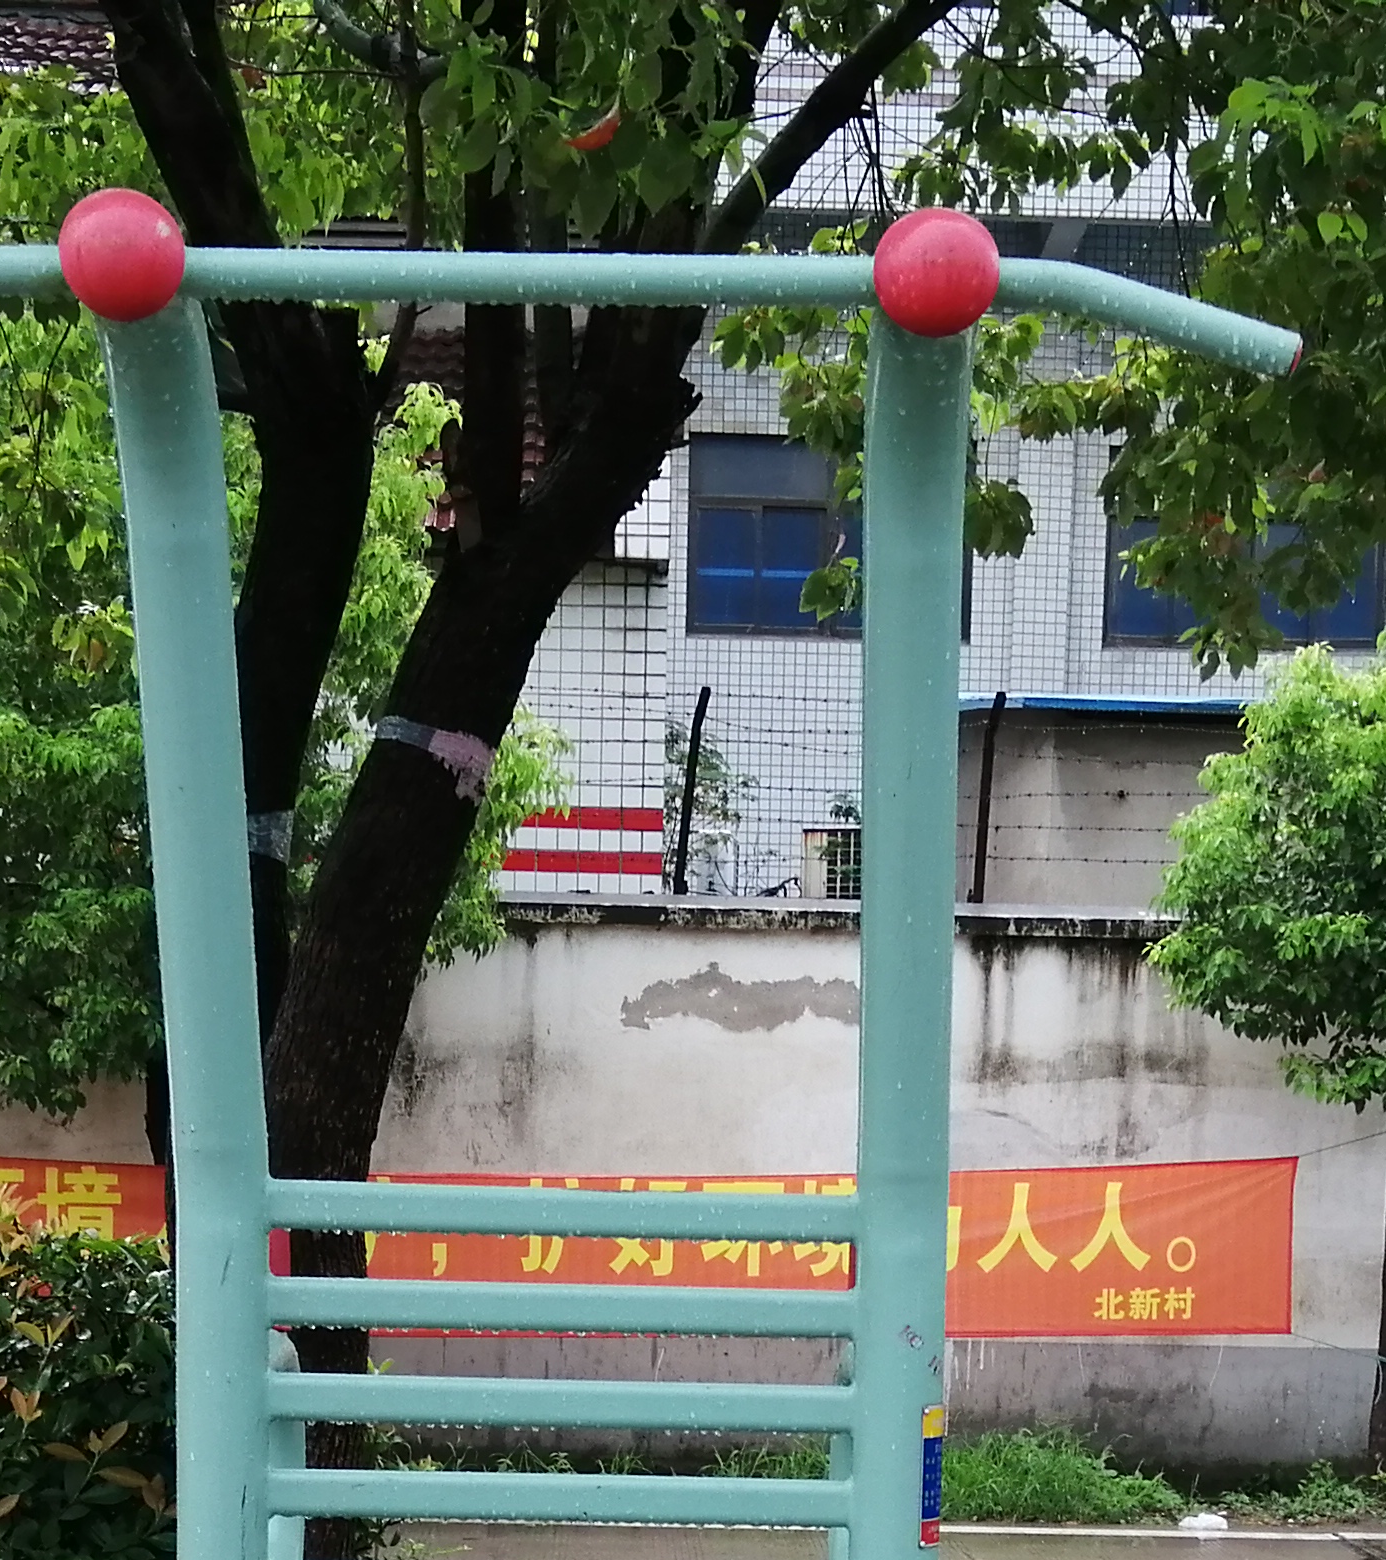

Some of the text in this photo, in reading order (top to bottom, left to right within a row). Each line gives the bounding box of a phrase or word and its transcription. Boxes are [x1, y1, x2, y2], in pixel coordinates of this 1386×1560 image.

[946, 1181, 1196, 1273] 人人。
[1094, 1286, 1196, 1321] 北新村
